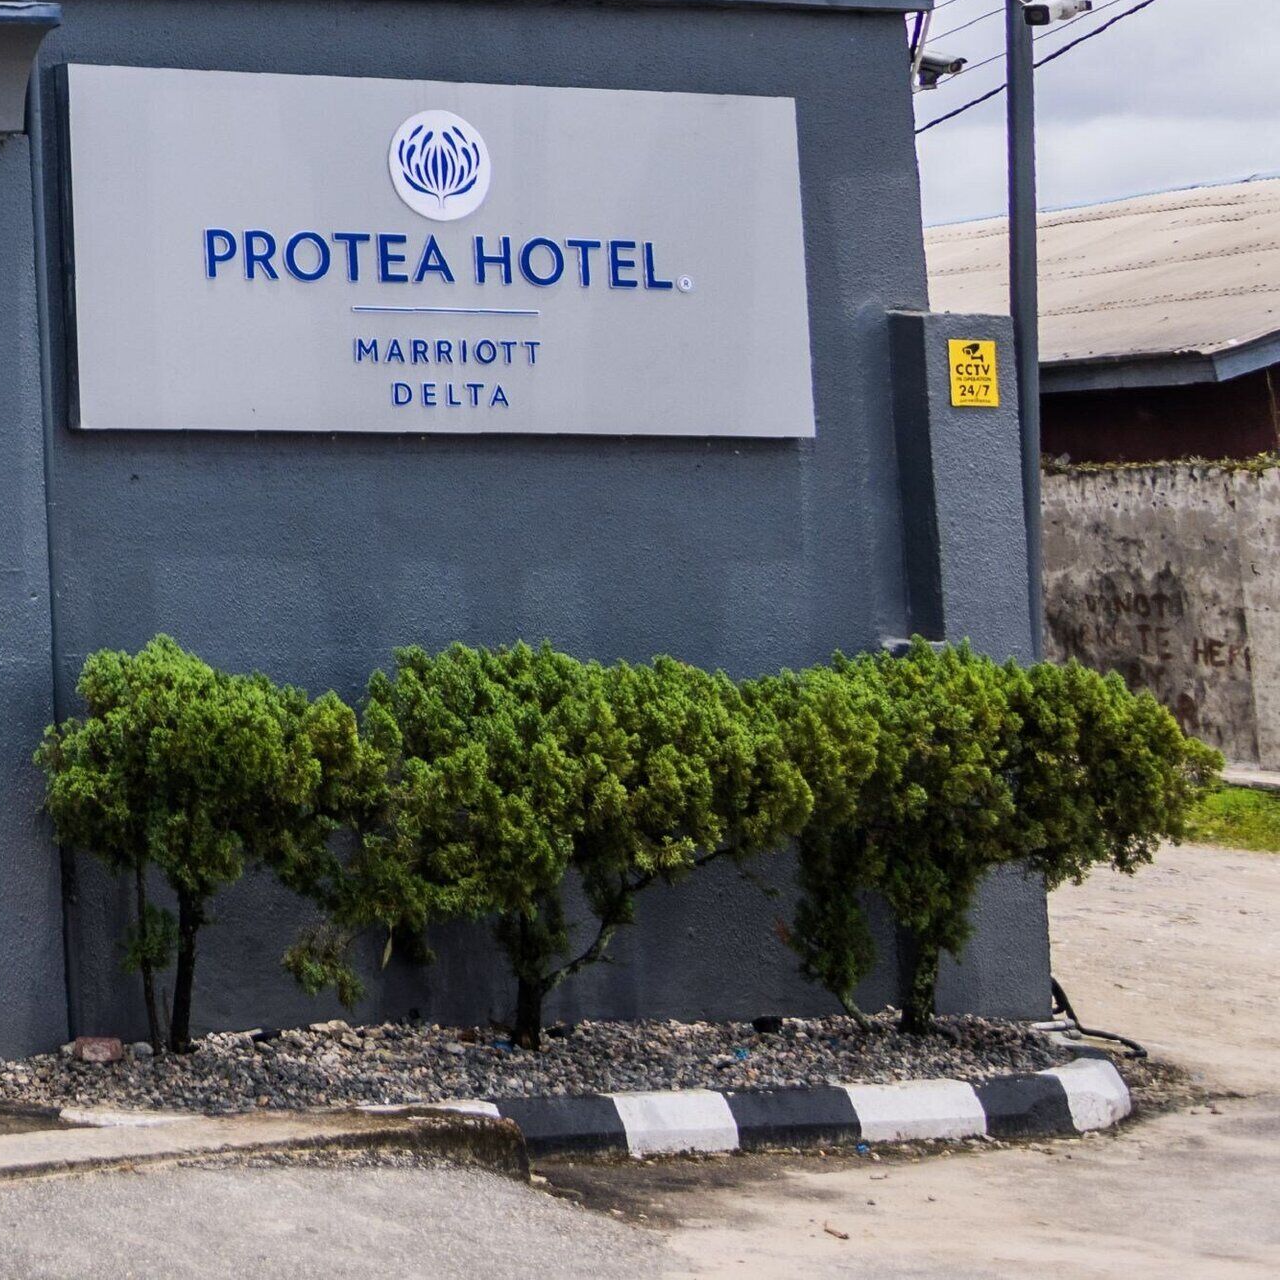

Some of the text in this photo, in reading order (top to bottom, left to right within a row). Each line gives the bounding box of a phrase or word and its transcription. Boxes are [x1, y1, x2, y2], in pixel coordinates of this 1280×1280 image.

[203, 229, 456, 285] PROTEA
[472, 236, 674, 291] HOTEL
[353, 337, 542, 366] MARRIOTT
[955, 363, 990, 376] CCTV
[390, 381, 510, 409] DELTA
[959, 384, 990, 397] 24/7
